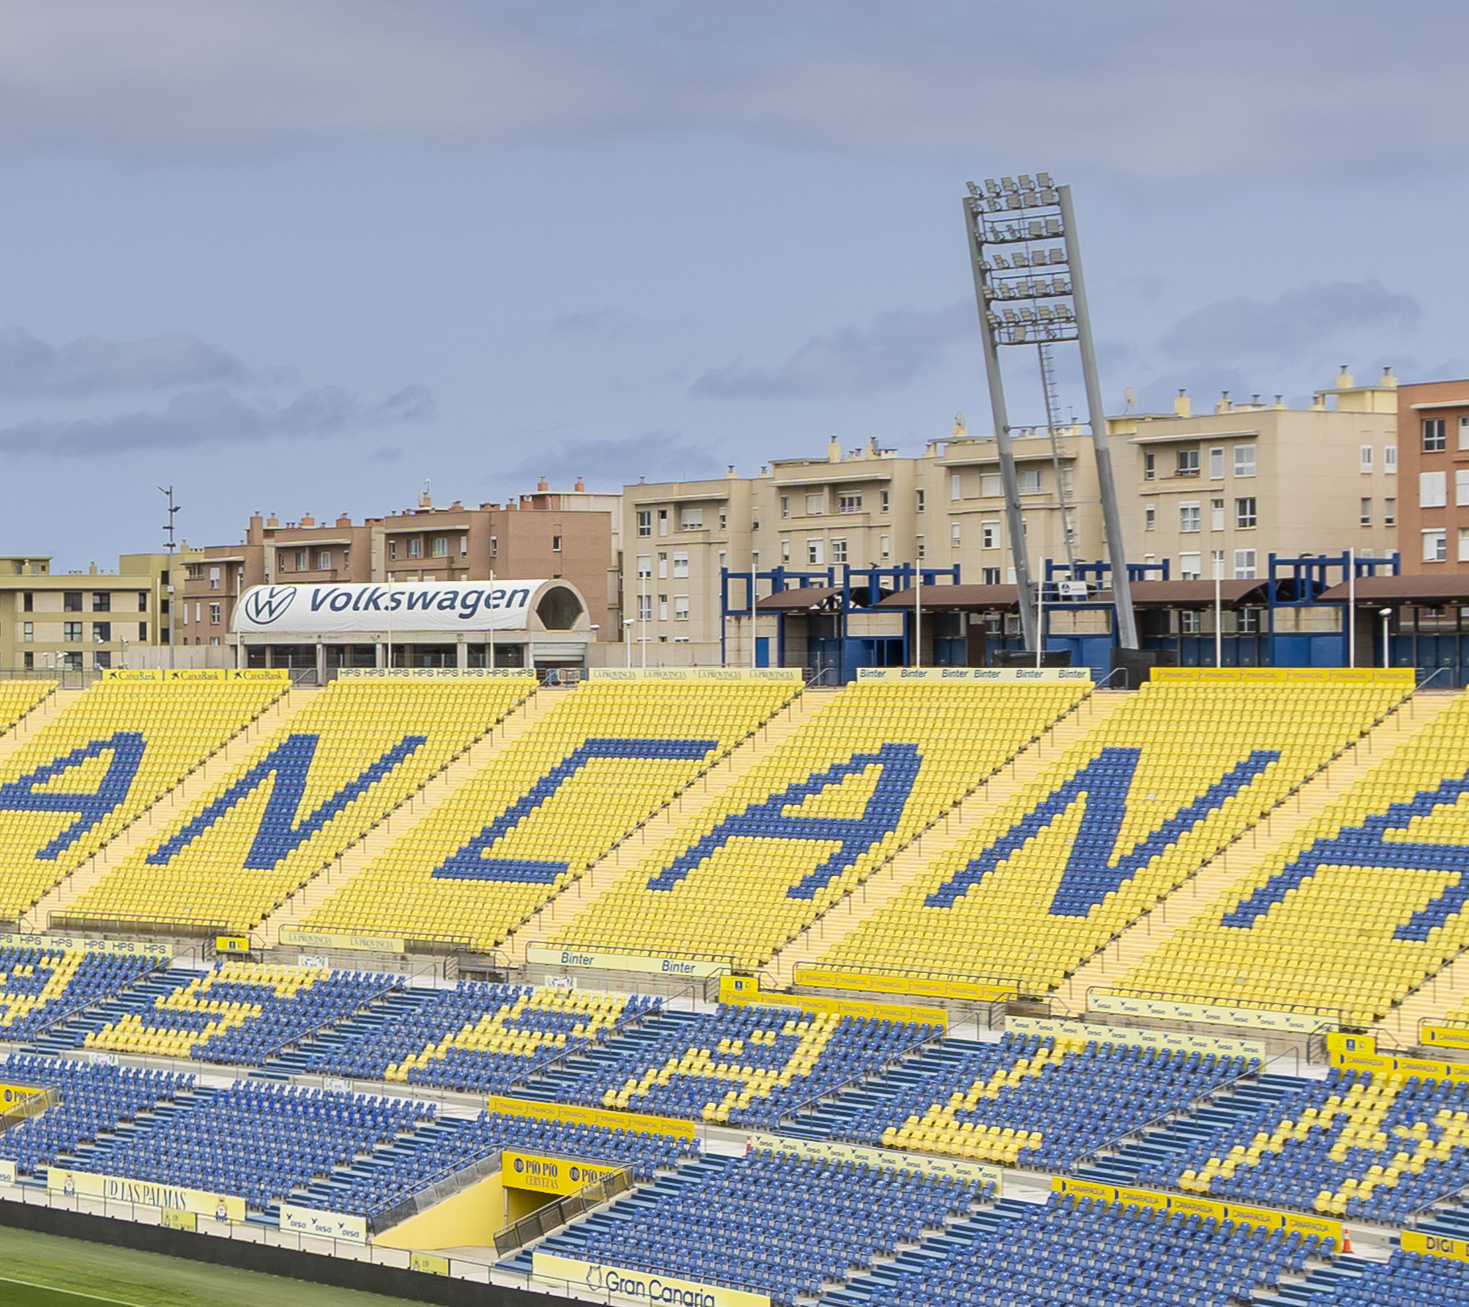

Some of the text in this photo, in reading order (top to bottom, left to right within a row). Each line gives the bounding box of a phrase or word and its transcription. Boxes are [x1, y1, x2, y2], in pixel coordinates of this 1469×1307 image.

[310, 587, 531, 619] Volkswagen
[561, 952, 594, 966] Binter
[661, 959, 696, 974] Binter
[103, 1179, 187, 1211] UD LAS PALMAS
[1425, 1236, 1454, 1254] DIGI
[606, 1271, 645, 1298] Gran
